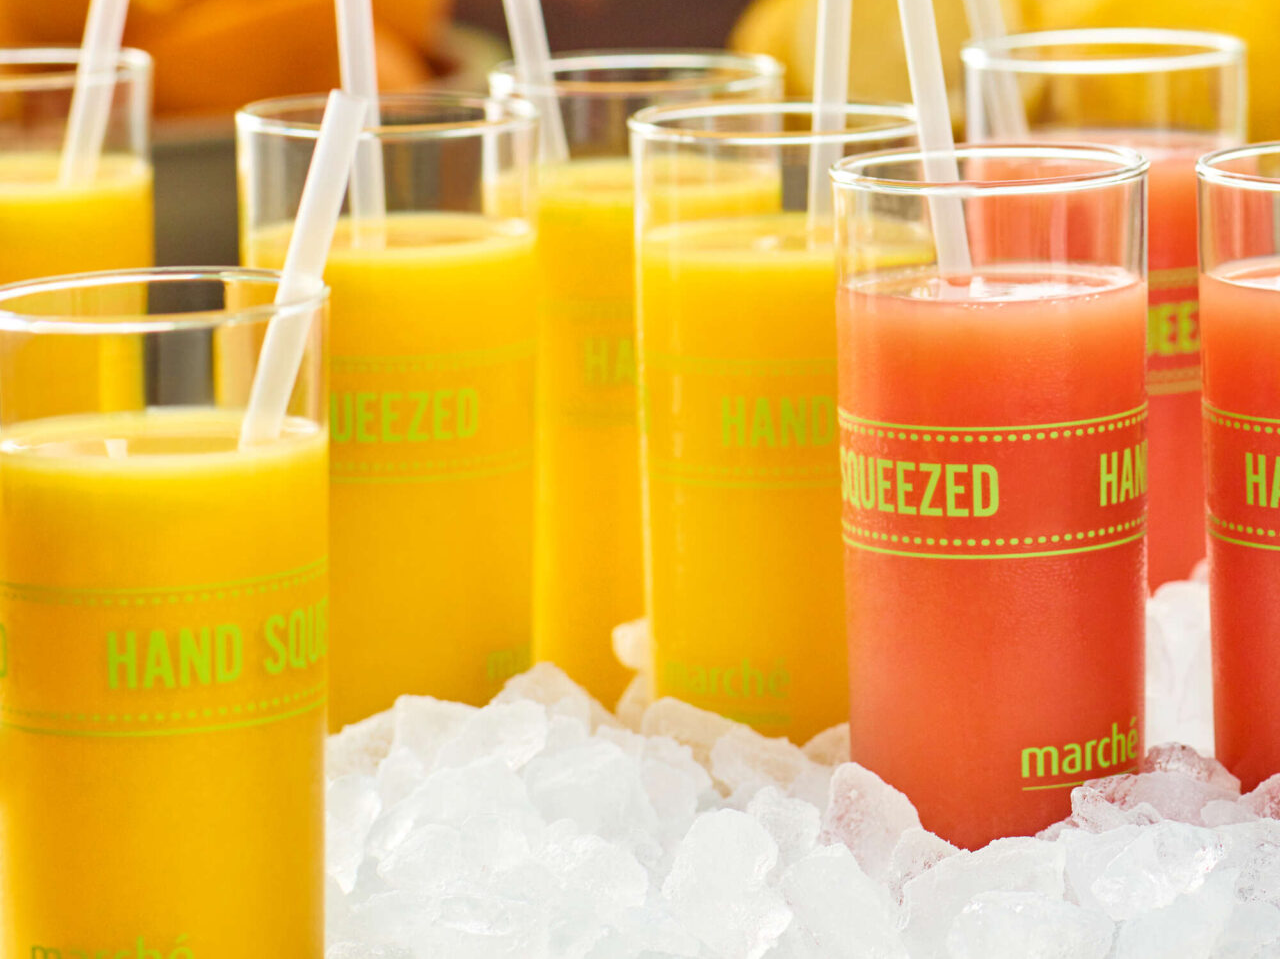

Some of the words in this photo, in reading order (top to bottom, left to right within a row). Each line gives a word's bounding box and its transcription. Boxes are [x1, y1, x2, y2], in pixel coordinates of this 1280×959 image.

[330, 388, 479, 443] UEEZED
[721, 395, 836, 448] HAND
[840, 444, 1000, 518] SQUEEZED
[105, 622, 244, 691] HAND
[1021, 715, 1139, 779] marché
